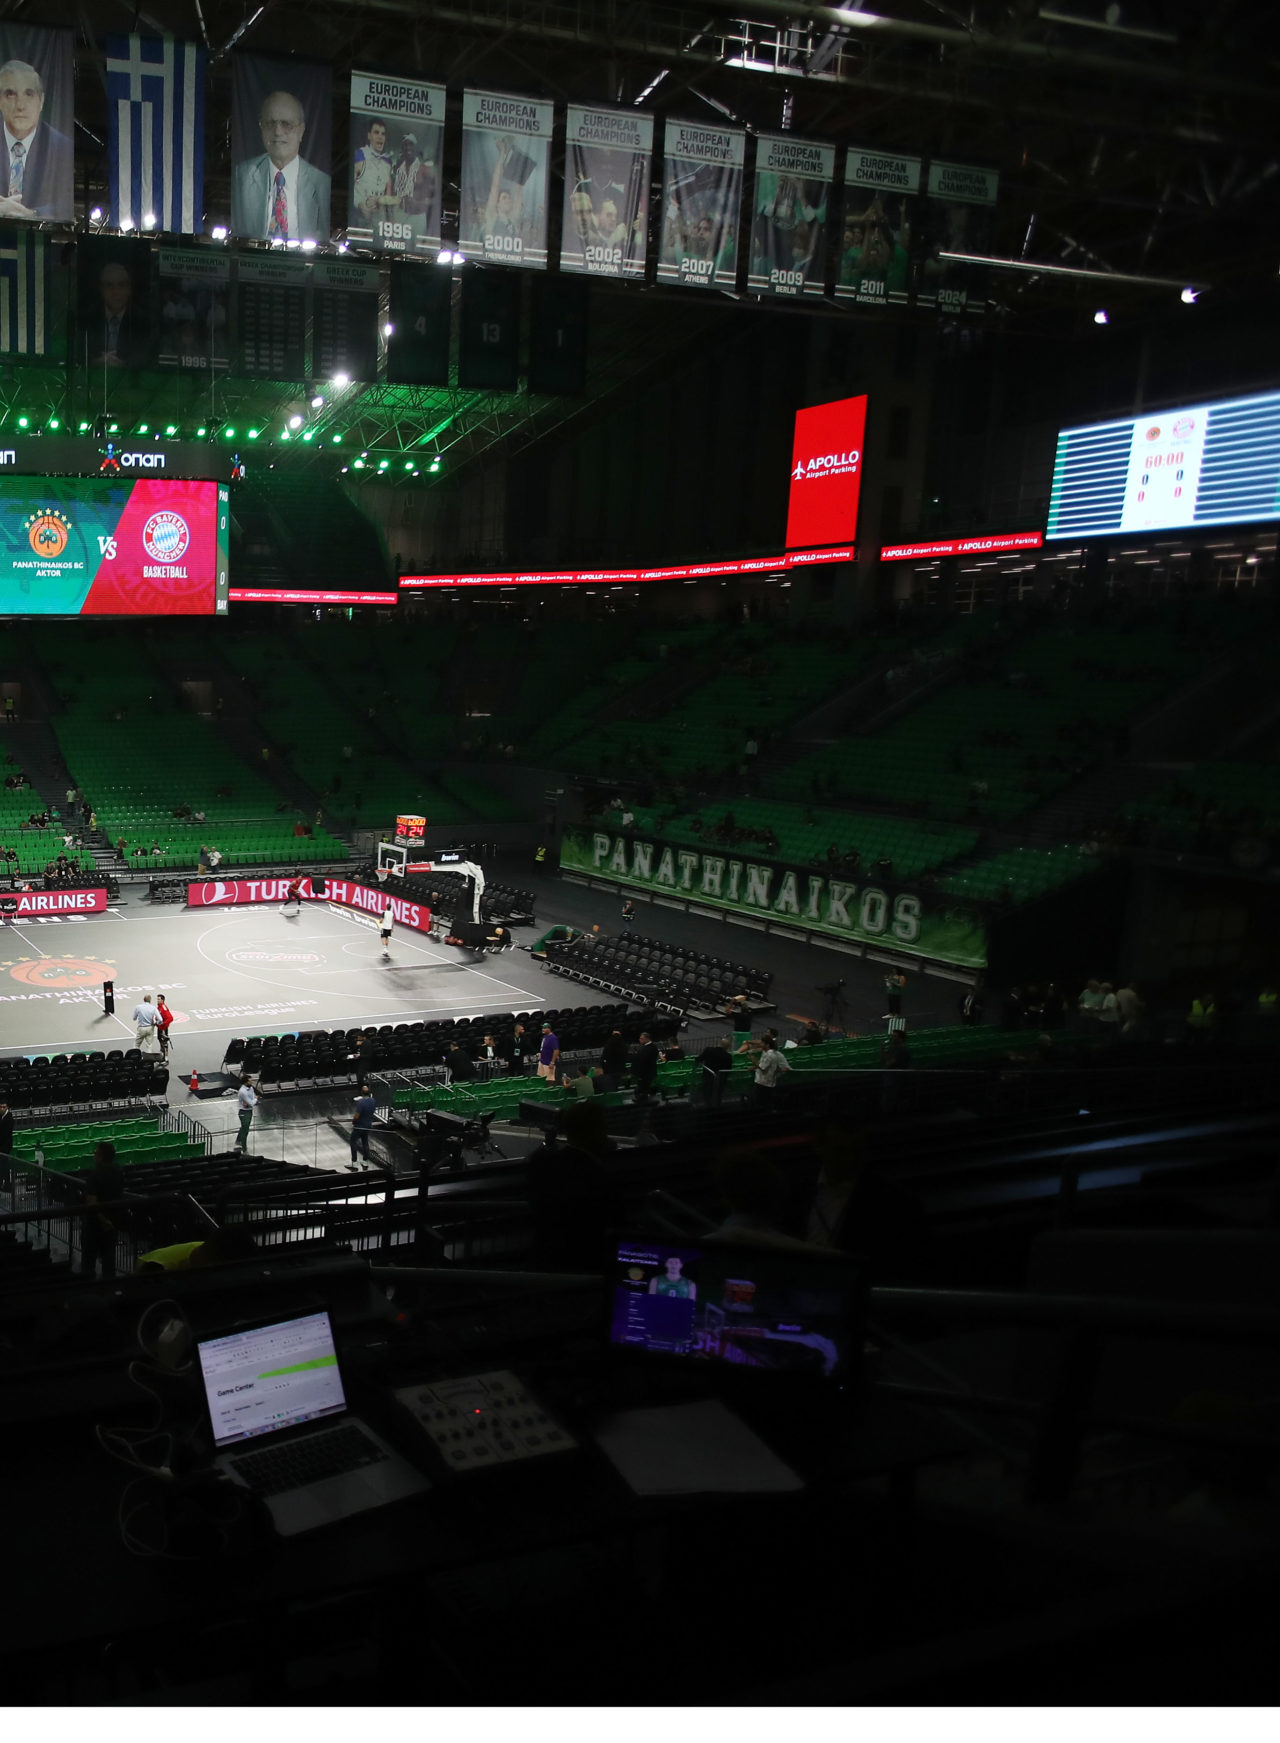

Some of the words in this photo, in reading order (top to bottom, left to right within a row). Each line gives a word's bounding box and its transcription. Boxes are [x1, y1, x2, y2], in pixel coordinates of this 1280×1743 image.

[369, 82, 430, 102] EUROPEAN
[364, 94, 432, 116] CHAMPIONS
[480, 99, 537, 119] EUROPEAN
[476, 112, 540, 132] CHAMPIONS
[583, 114, 638, 133] EUROPEAN
[578, 126, 641, 146] CHAMPIONS
[680, 129, 731, 148] EUROPEAN
[676, 141, 734, 160] CHAMPIONS
[772, 144, 822, 161] EUROPEAN
[768, 156, 823, 174] CHAMPIONS
[860, 156, 907, 174] EUROPEAN
[856, 168, 909, 186] CHAMPIONS
[378, 221, 412, 240] 1996
[384, 240, 406, 250] PARIS
[484, 235, 523, 252] 2000
[586, 246, 622, 264] 2002
[588, 262, 618, 273] BOLOGNA
[681, 258, 714, 276] 2007
[684, 274, 708, 285] ATHENS
[770, 269, 804, 286] 2009
[775, 284, 797, 294] BERLIN
[860, 280, 885, 295] 2011
[806, 450, 859, 470] APOLLO
[1145, 452, 1184, 469] 60:00
[806, 468, 829, 479] Airport
[830, 464, 856, 476] Parking
[156, 514, 186, 534] BAYERN
[97, 536, 118, 560] VS
[962, 541, 992, 550] APOLLO
[992, 539, 1014, 548] Airport
[1014, 537, 1038, 545] Parking
[792, 554, 816, 562] APOLLO
[886, 549, 912, 557] APOLLO
[144, 566, 188, 578] BASKETBALL
[409, 826, 424, 838] 24
[441, 853, 459, 862] bwin
[593, 832, 921, 943] PANATHINAIKOS
[18, 893, 96, 912] AIRLINES
